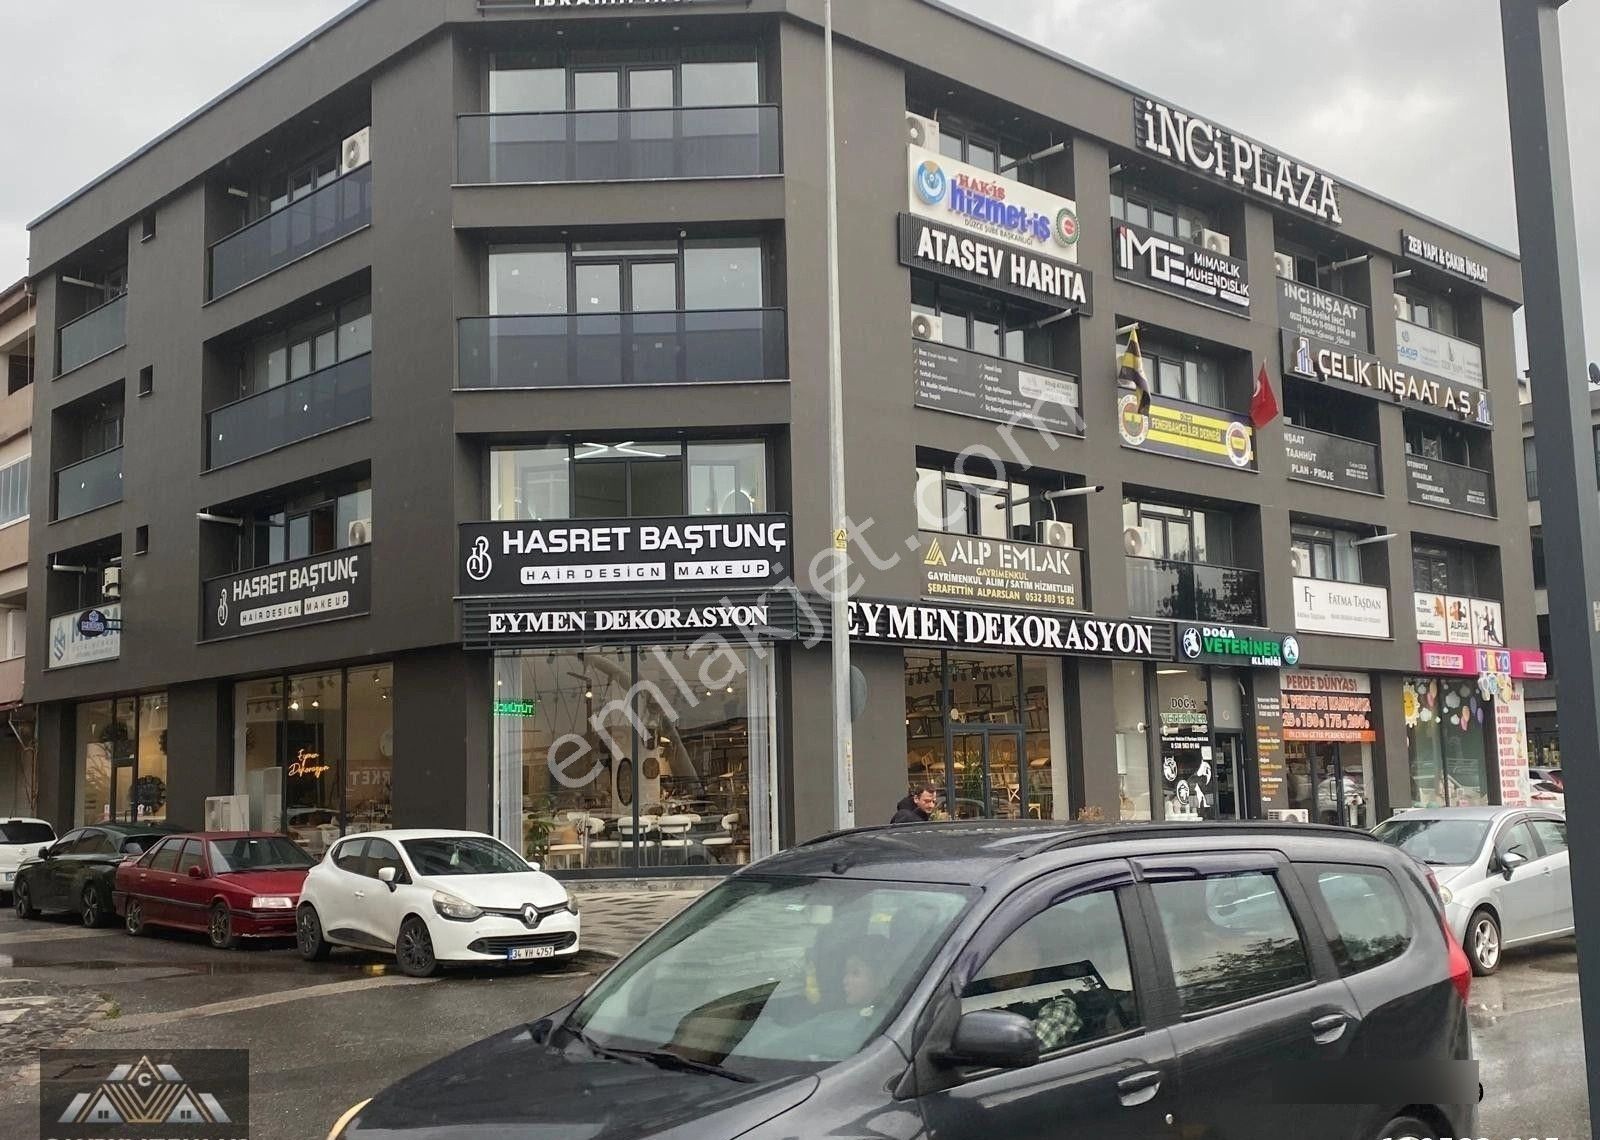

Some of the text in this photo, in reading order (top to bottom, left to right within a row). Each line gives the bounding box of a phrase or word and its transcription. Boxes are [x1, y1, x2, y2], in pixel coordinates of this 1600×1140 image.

[1230, 136, 1342, 224] PLAZA
[918, 226, 1004, 278] ATASEV
[1408, 235, 1422, 256] ZER
[1422, 240, 1438, 262] YAPI
[1439, 248, 1446, 265] &
[1318, 349, 1372, 386] ÇELİK
[1377, 360, 1440, 404] İNŞAAT
[1292, 464, 1309, 475] PLAN
[1314, 468, 1334, 480] PROJE
[503, 523, 786, 554] HASRET BAŞTUNÇ
[951, 539, 1070, 575] ALP EMLAK
[233, 556, 358, 602] HASRET BAŞTUNÇ
[678, 564, 764, 576] MAKE UP
[976, 568, 1028, 580] GAYRİMENKUL
[928, 571, 982, 586] GAYRİMENKUL
[986, 578, 1004, 588] ALIM
[1010, 579, 1034, 590] SATIM
[1034, 580, 1074, 594] HİZMETLERİ
[928, 583, 974, 596] ŞERAFETTİN
[977, 588, 1020, 600] ALPARSLAN
[1026, 593, 1042, 603] 0532
[1044, 594, 1056, 604] 303
[1057, 595, 1065, 604] 15
[489, 606, 768, 634] EYMEN DEKORASYON
[848, 601, 1152, 654] EYMEN DEKORASYON
[1203, 626, 1236, 639] DOĞA
[1204, 637, 1280, 656] VETERİNER
[1286, 674, 1358, 692] PERDE DÜNYASI
[1171, 695, 1196, 709] DOĞA
[1160, 711, 1208, 724] VETERİNER
